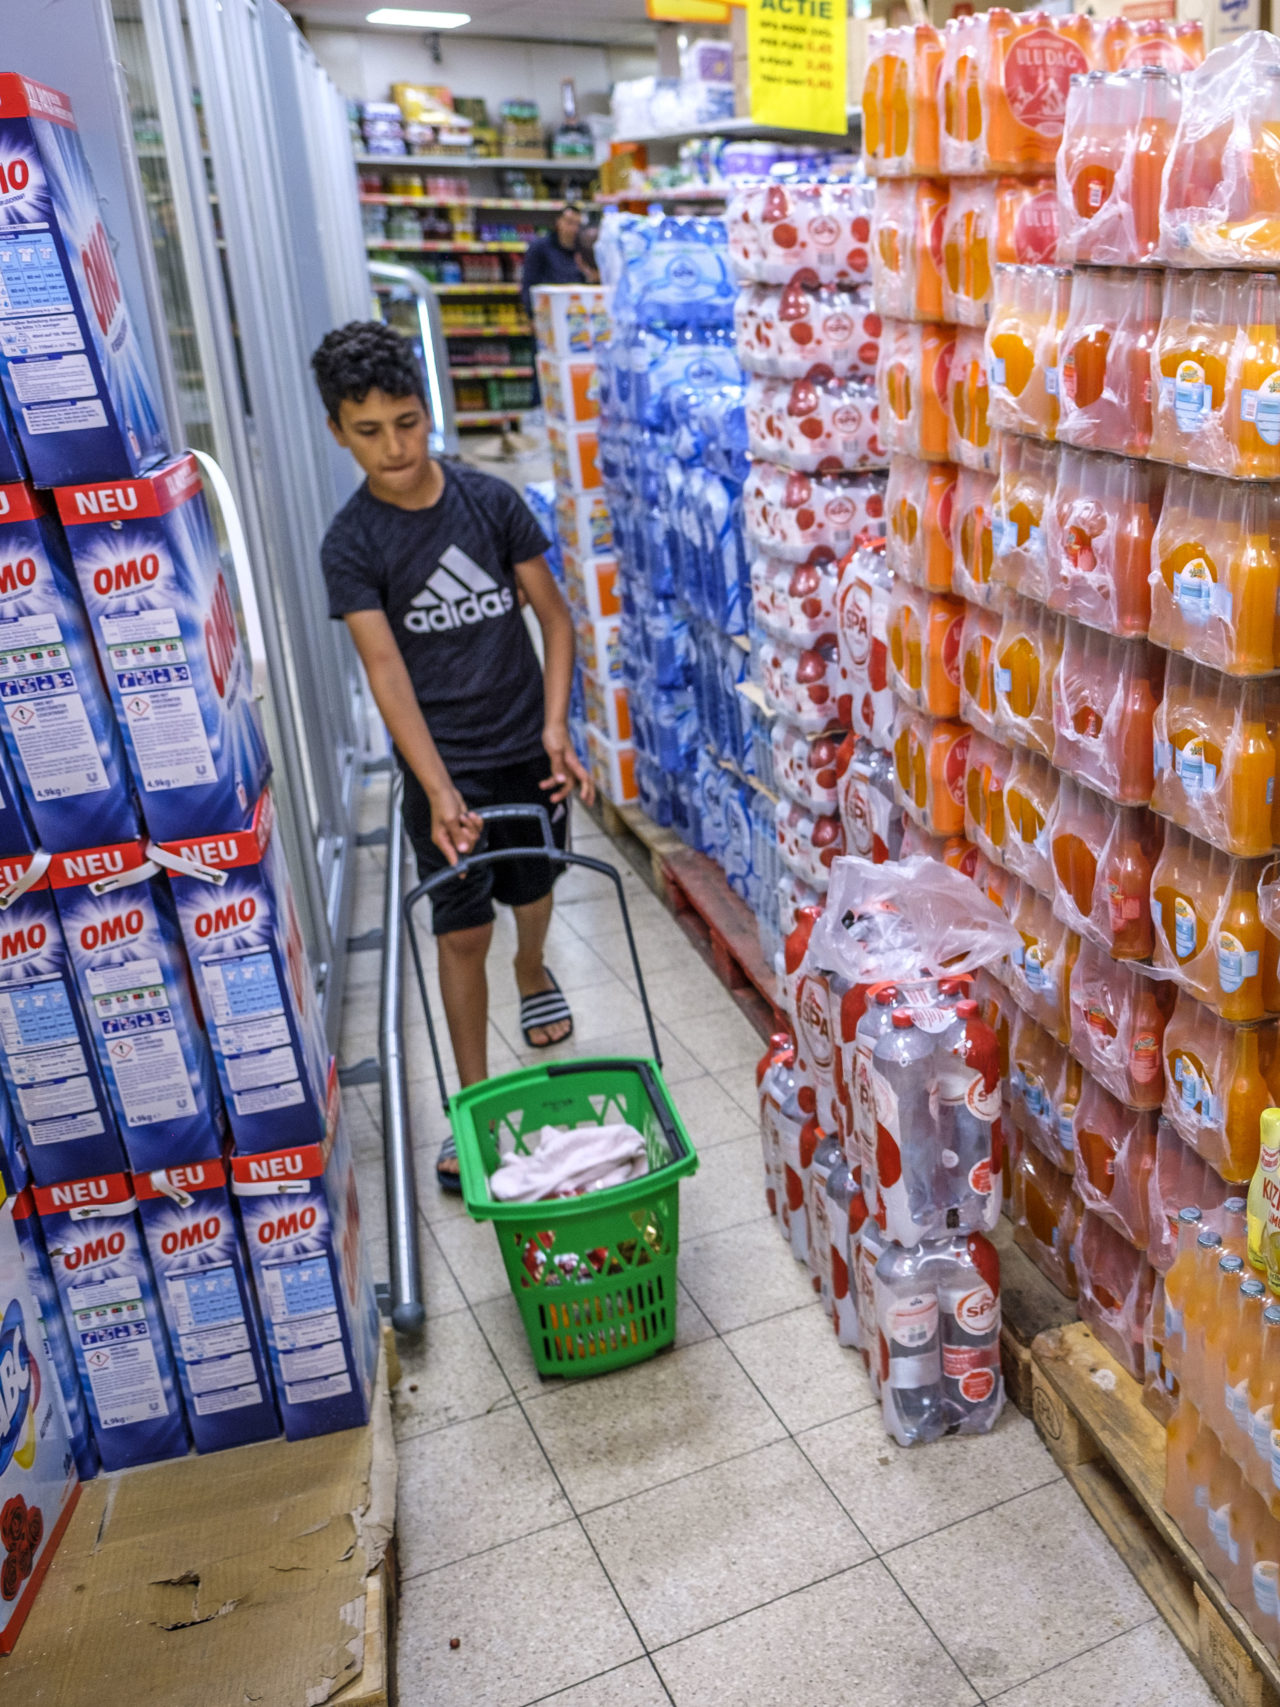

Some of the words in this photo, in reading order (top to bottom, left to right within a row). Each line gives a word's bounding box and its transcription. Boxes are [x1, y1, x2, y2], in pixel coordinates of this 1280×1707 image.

[74, 486, 138, 516] NEU
[0, 557, 36, 595] MO
[93, 552, 160, 597] OMO
[403, 586, 514, 634] adidas
[63, 850, 124, 880] NEU
[180, 838, 240, 867] NEU
[80, 909, 144, 951] OMO
[194, 896, 257, 938] OMO
[0, 923, 46, 960] MO
[802, 1000, 830, 1038] SPA
[165, 1164, 206, 1189] EU
[249, 1152, 304, 1181] NEU
[51, 1178, 110, 1206] NEU
[160, 1214, 221, 1257] OMO
[257, 1205, 317, 1244] OMO
[63, 1230, 126, 1272] OMO
